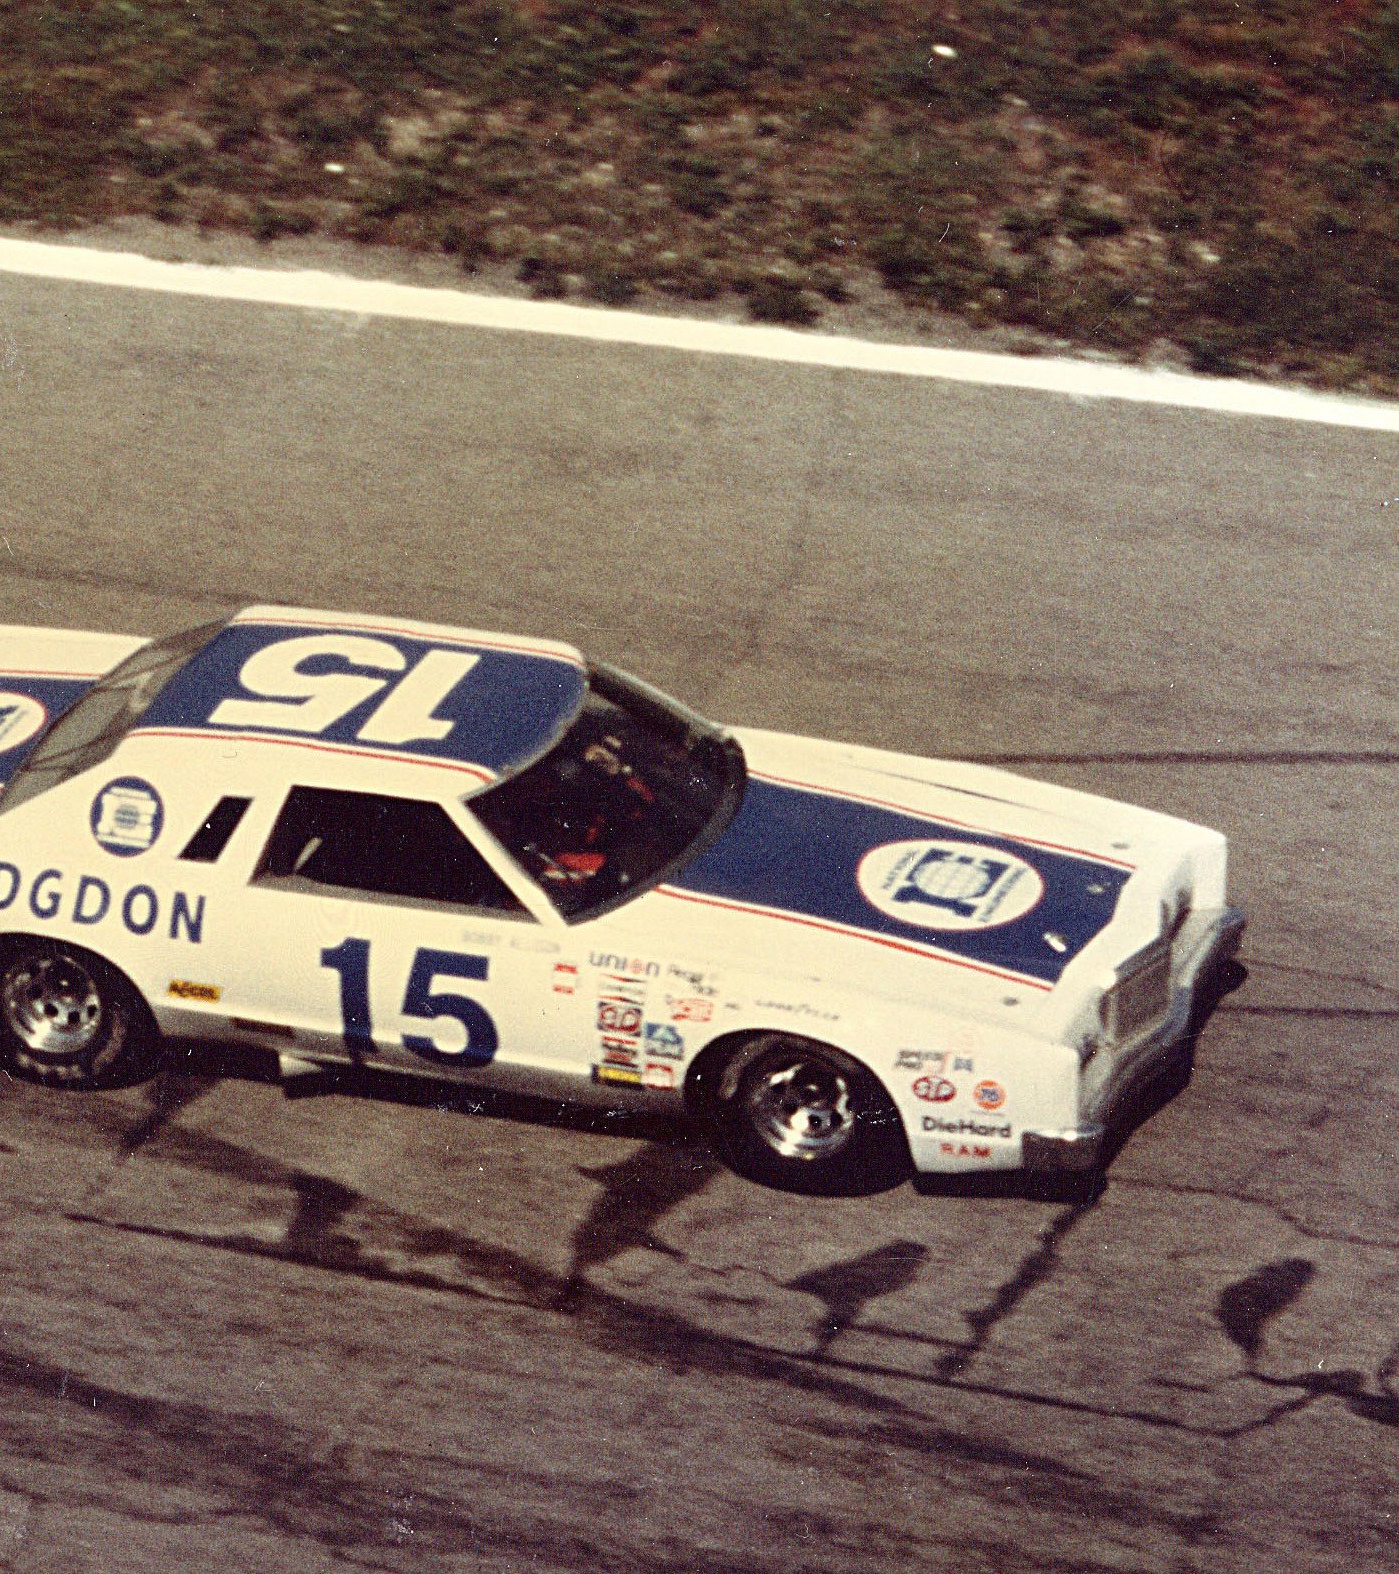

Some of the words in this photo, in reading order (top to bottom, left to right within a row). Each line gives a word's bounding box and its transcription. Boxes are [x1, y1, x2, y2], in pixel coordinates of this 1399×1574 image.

[208, 634, 482, 744] 15
[320, 936, 499, 1067] 15
[922, 1115, 1012, 1138] DieHard
[940, 1143, 992, 1159] RAM
